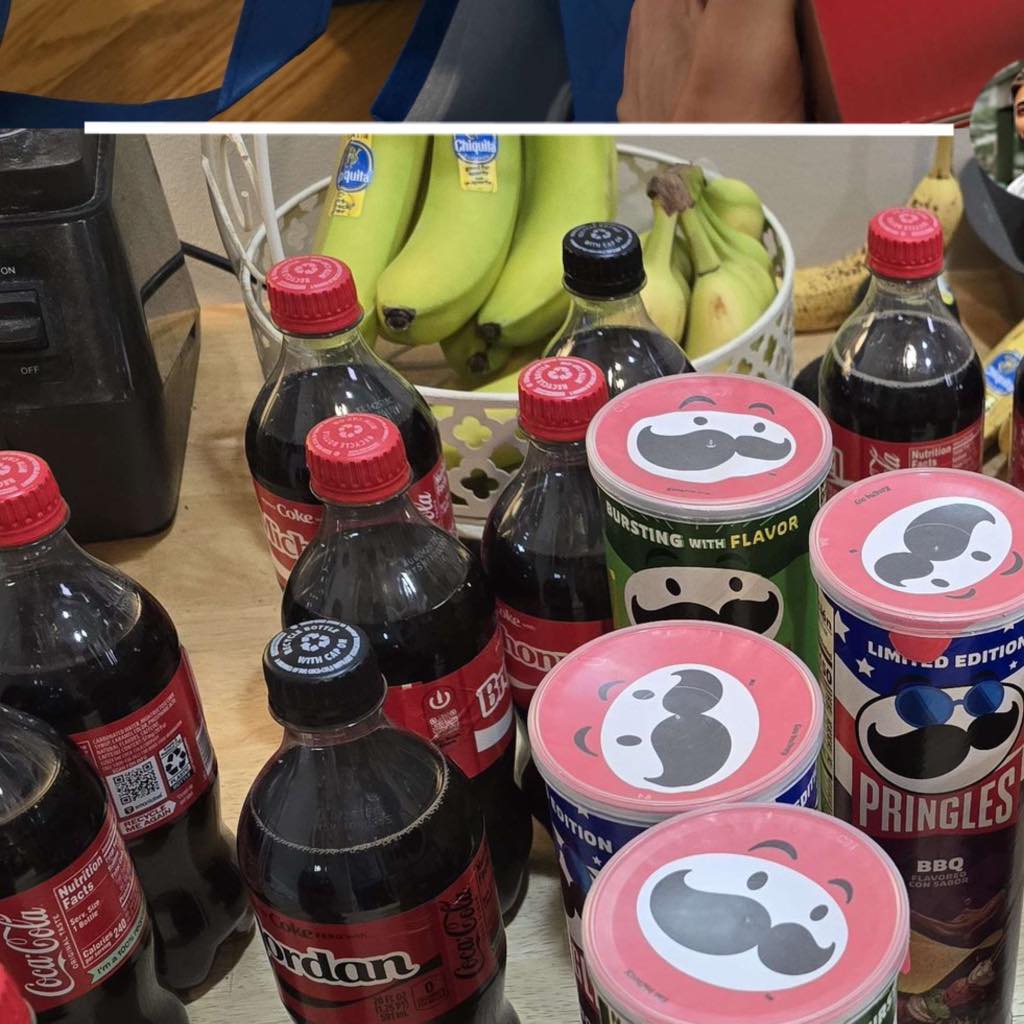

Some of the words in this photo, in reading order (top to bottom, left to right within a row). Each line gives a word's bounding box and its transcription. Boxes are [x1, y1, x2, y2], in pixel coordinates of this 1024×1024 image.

[455, 139, 497, 154] Chiquita
[0, 266, 16, 275] ON
[20, 366, 39, 375] OFF
[912, 445, 950, 460] Nutrition
[277, 502, 314, 524] Coke
[606, 501, 684, 549] BURSTING
[689, 538, 726, 550] WITH
[730, 514, 799, 550] FLAVOR
[859, 767, 1017, 833] PRINGLES
[124, 804, 168, 827] RECYCLE
[126, 823, 140, 833] ME
[143, 808, 171, 829] AGAIN
[917, 857, 964, 873] BBQ
[58, 856, 103, 899] Nutrition
[909, 880, 930, 888] CON
[933, 878, 968, 888] SABOR
[62, 881, 94, 909] Facts
[79, 910, 99, 930] Bottle
[82, 931, 113, 958] Calories
[113, 917, 127, 938] 240
[62, 936, 79, 970] ORIGINAL
